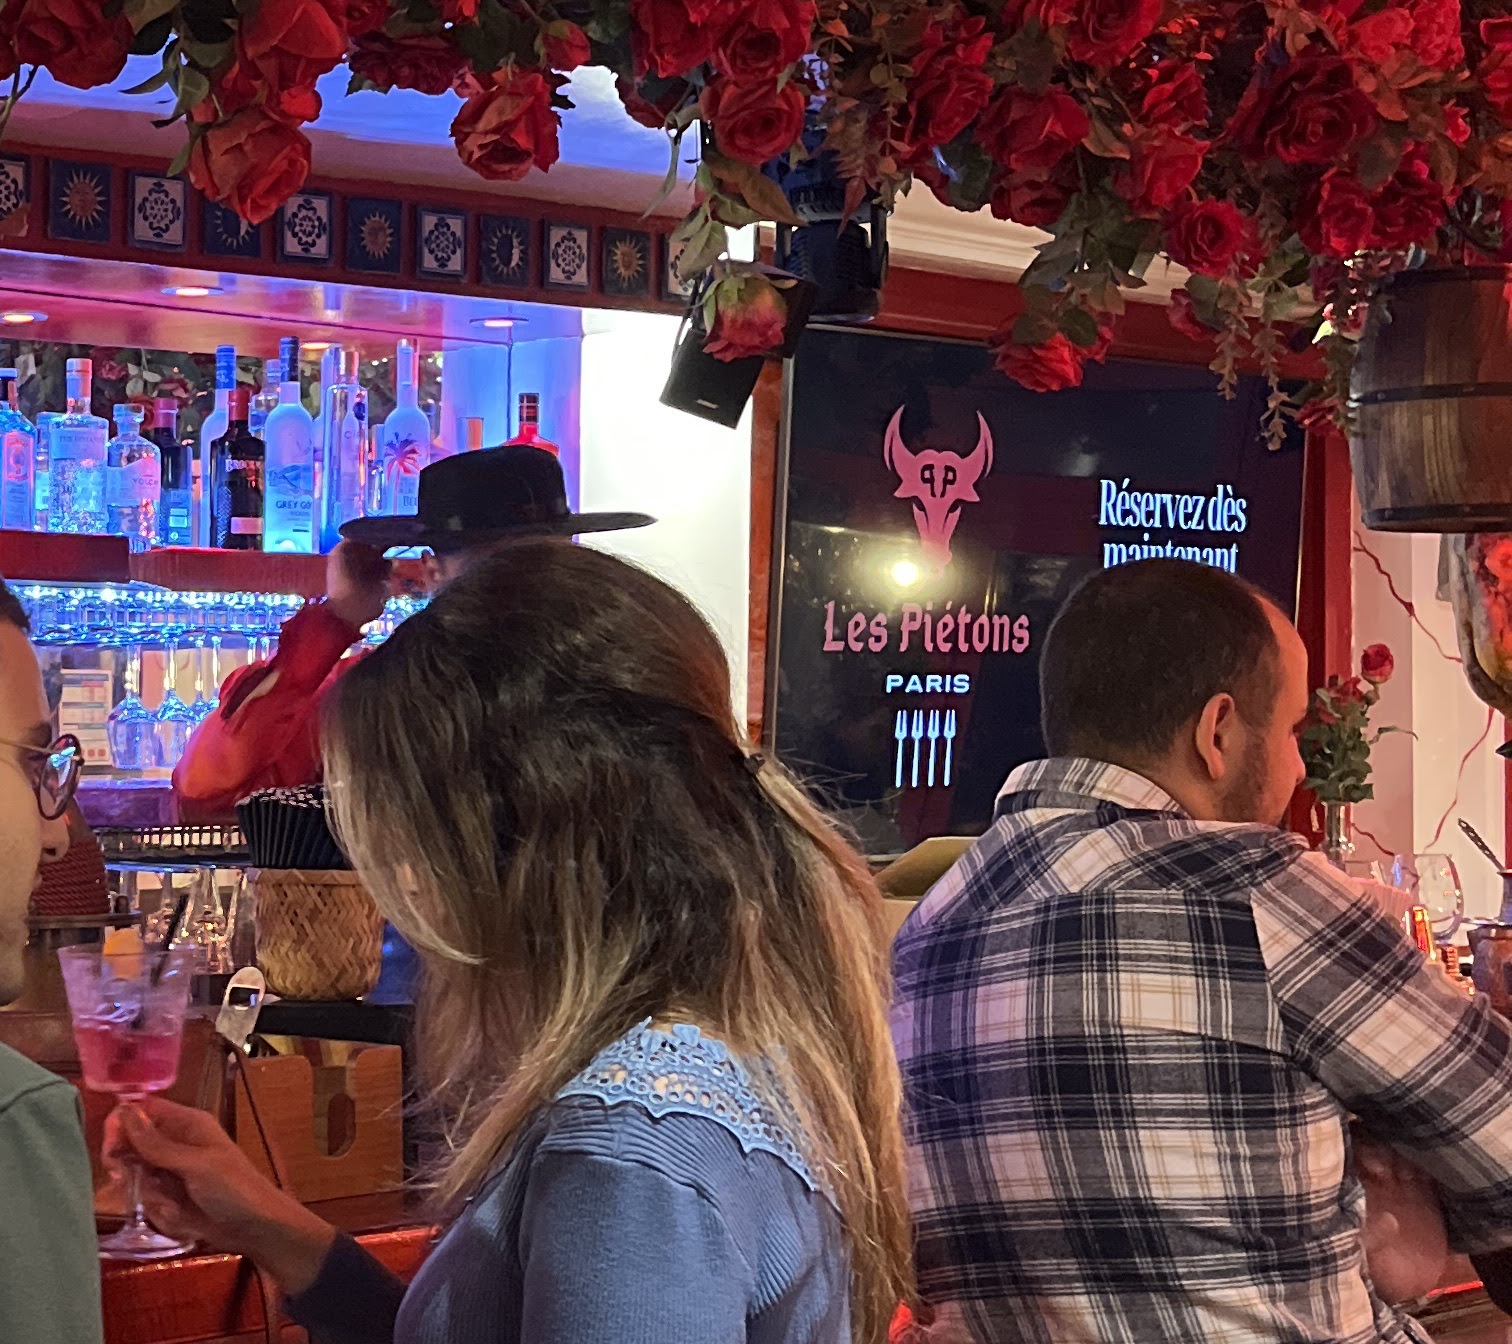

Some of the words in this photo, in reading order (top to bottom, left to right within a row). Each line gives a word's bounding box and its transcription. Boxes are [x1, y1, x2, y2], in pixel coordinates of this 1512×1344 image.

[1098, 477, 1205, 530] Réservez
[1207, 484, 1248, 533] dès
[823, 600, 888, 653] Les
[899, 600, 1030, 654] Piétons
[885, 674, 970, 694] PARIS
